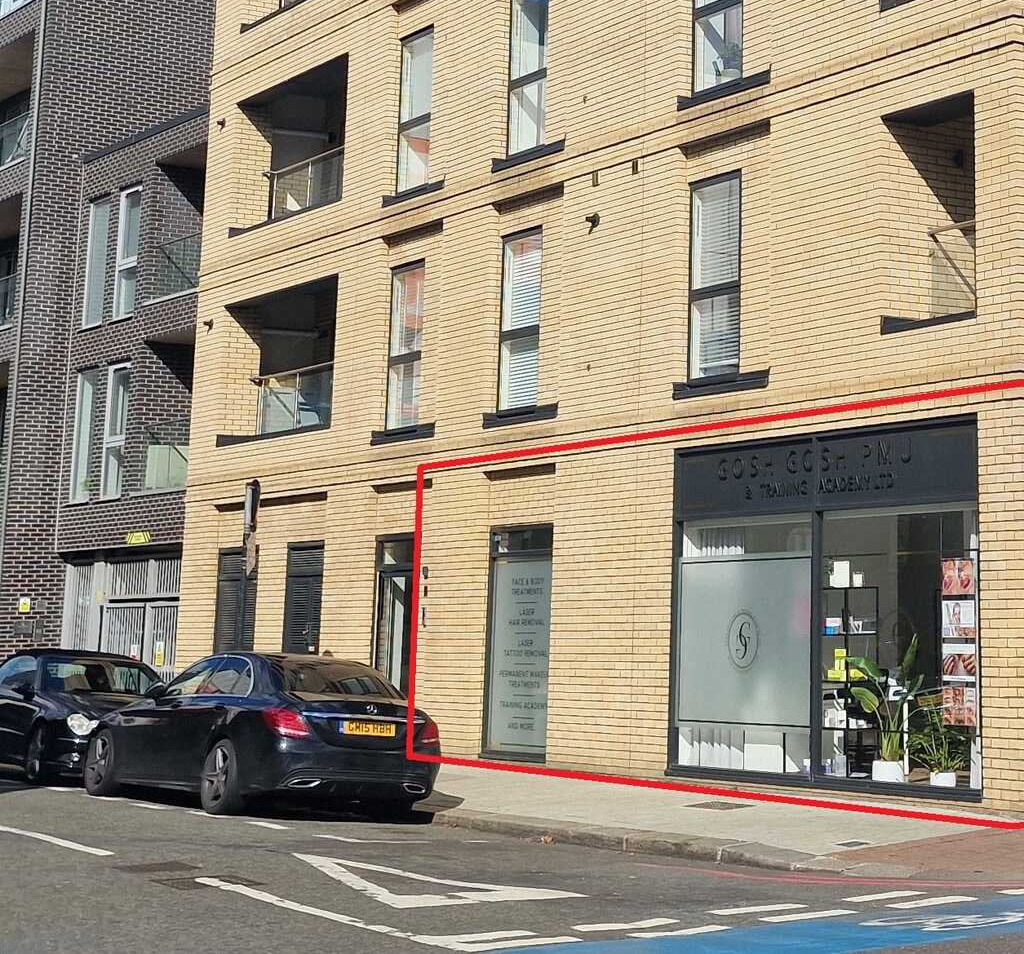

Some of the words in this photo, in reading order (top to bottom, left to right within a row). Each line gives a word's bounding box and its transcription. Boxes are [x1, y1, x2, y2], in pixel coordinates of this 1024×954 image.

[718, 450, 776, 481] GOSH
[786, 446, 848, 474] GOSH
[511, 587, 543, 595] TREATMENTS
[519, 608, 535, 616] LASER
[518, 639, 533, 647] LASER
[508, 680, 540, 688] TREATMENTS
